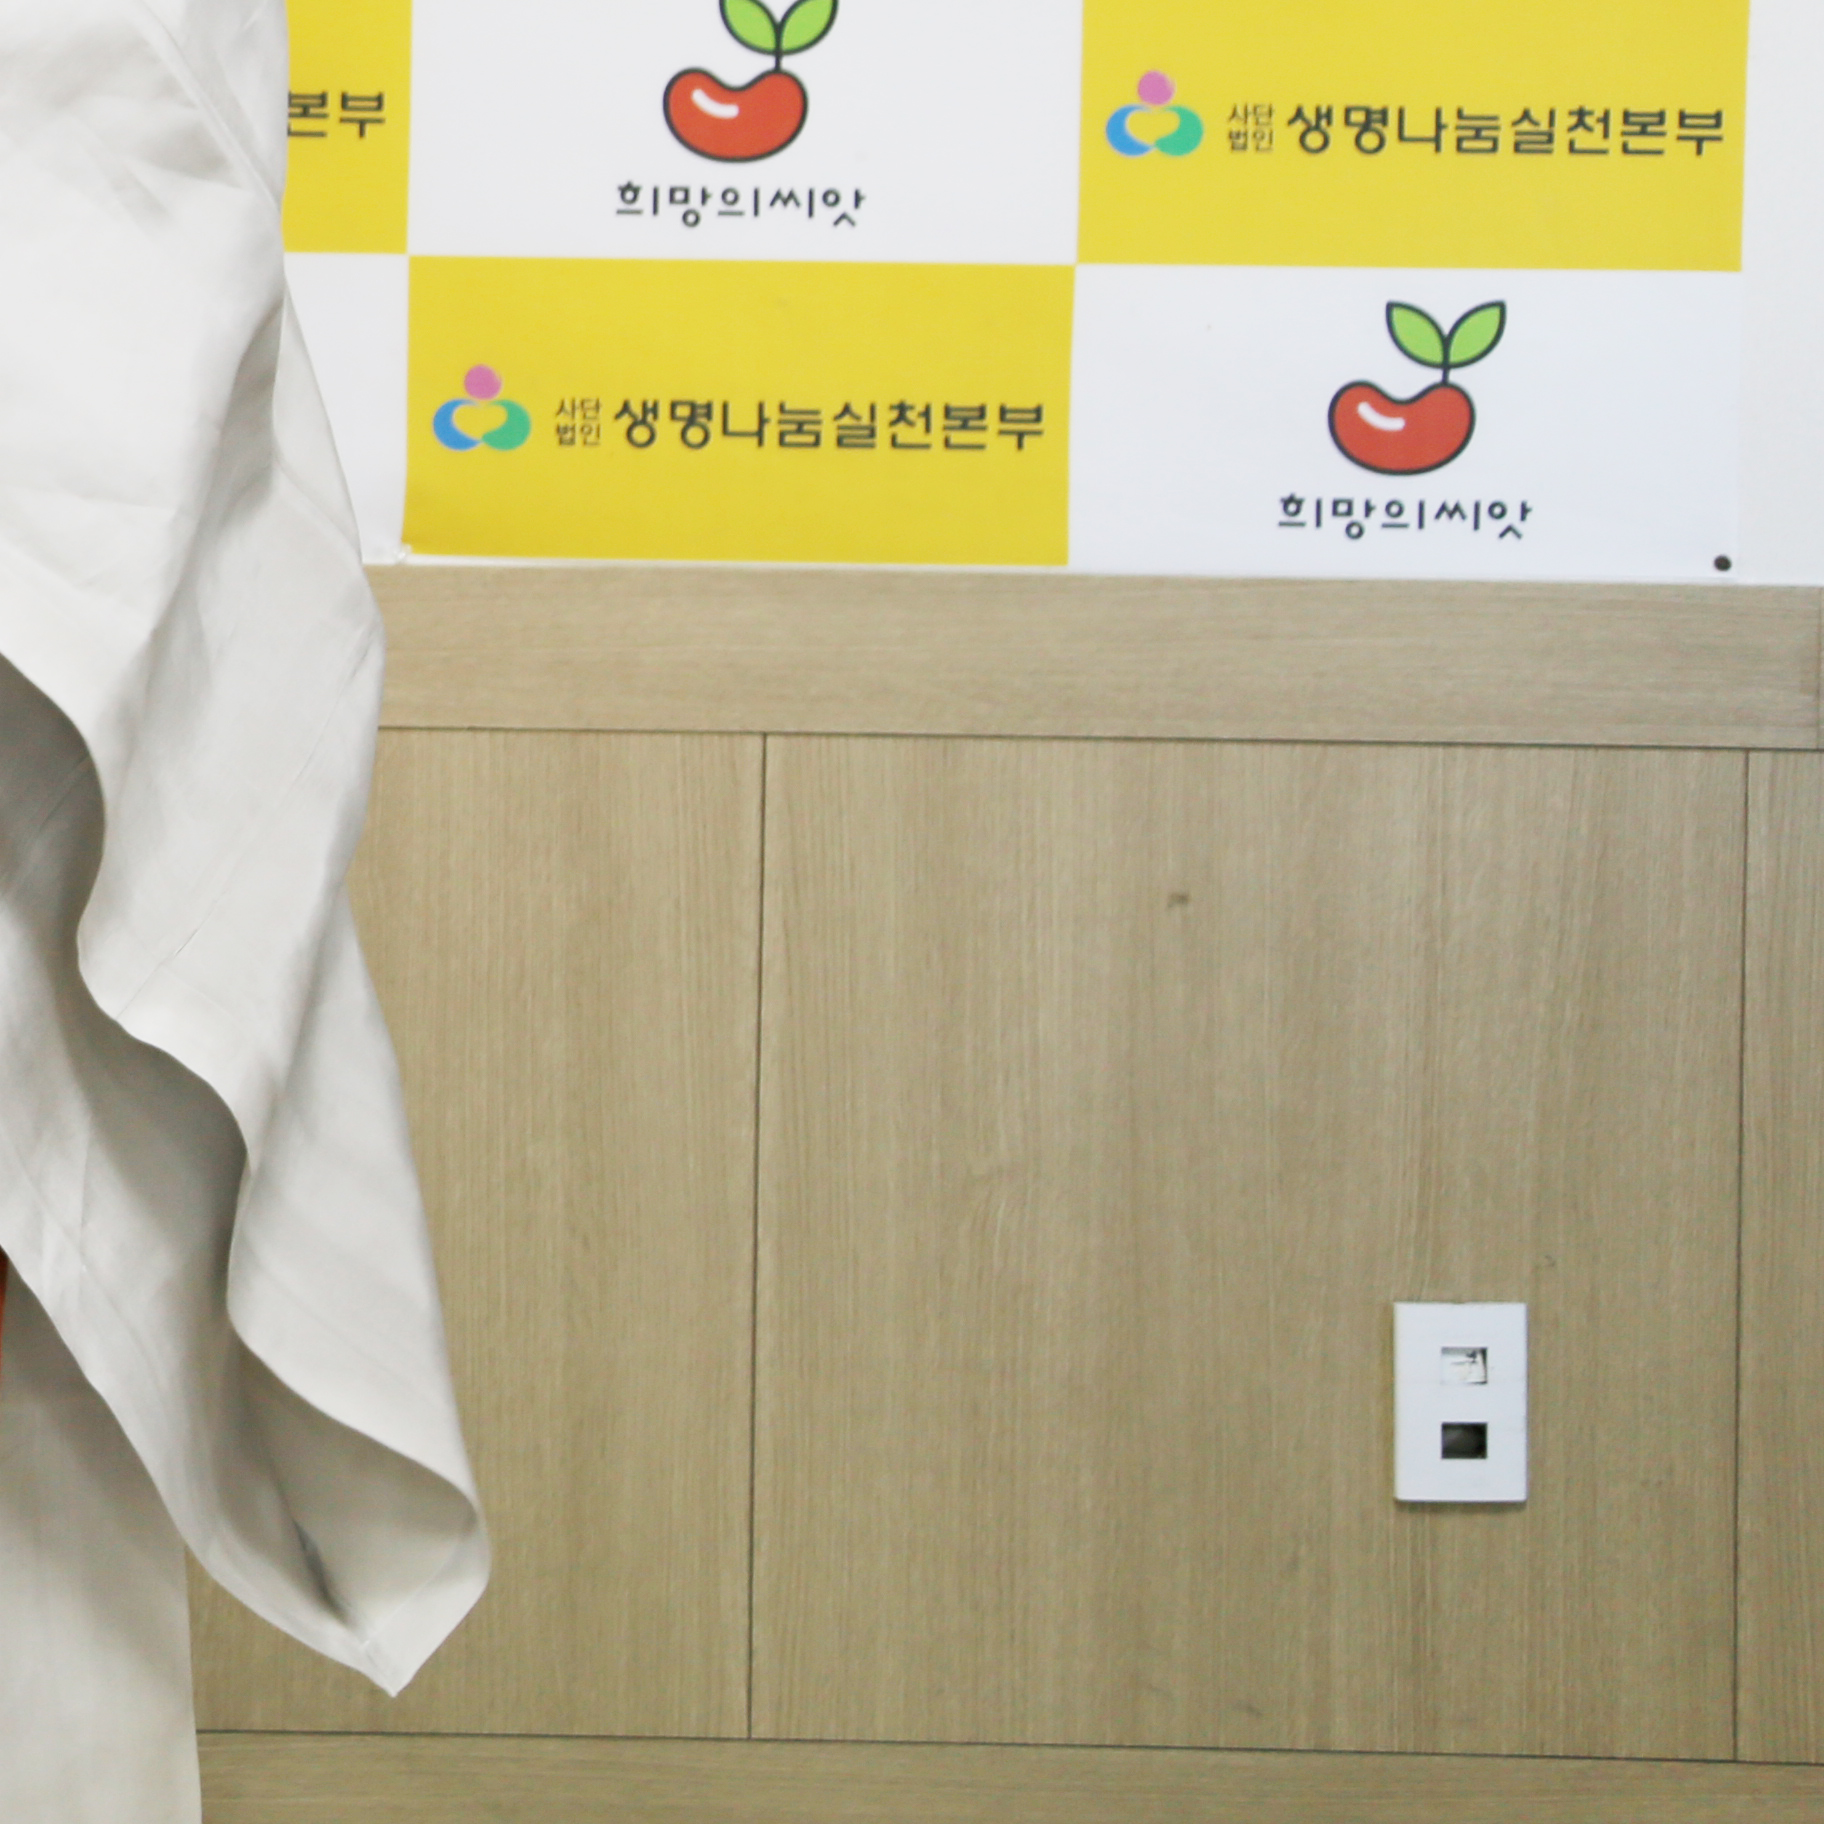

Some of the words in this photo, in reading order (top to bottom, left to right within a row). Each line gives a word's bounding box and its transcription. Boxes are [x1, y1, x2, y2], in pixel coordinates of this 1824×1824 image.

[1287, 105, 1724, 156] 생명나눔실천본부
[616, 181, 865, 228] 희망의씨앗
[614, 399, 1044, 451] 생명나눔실천본부
[1279, 494, 1532, 540] 희망의씨앗
